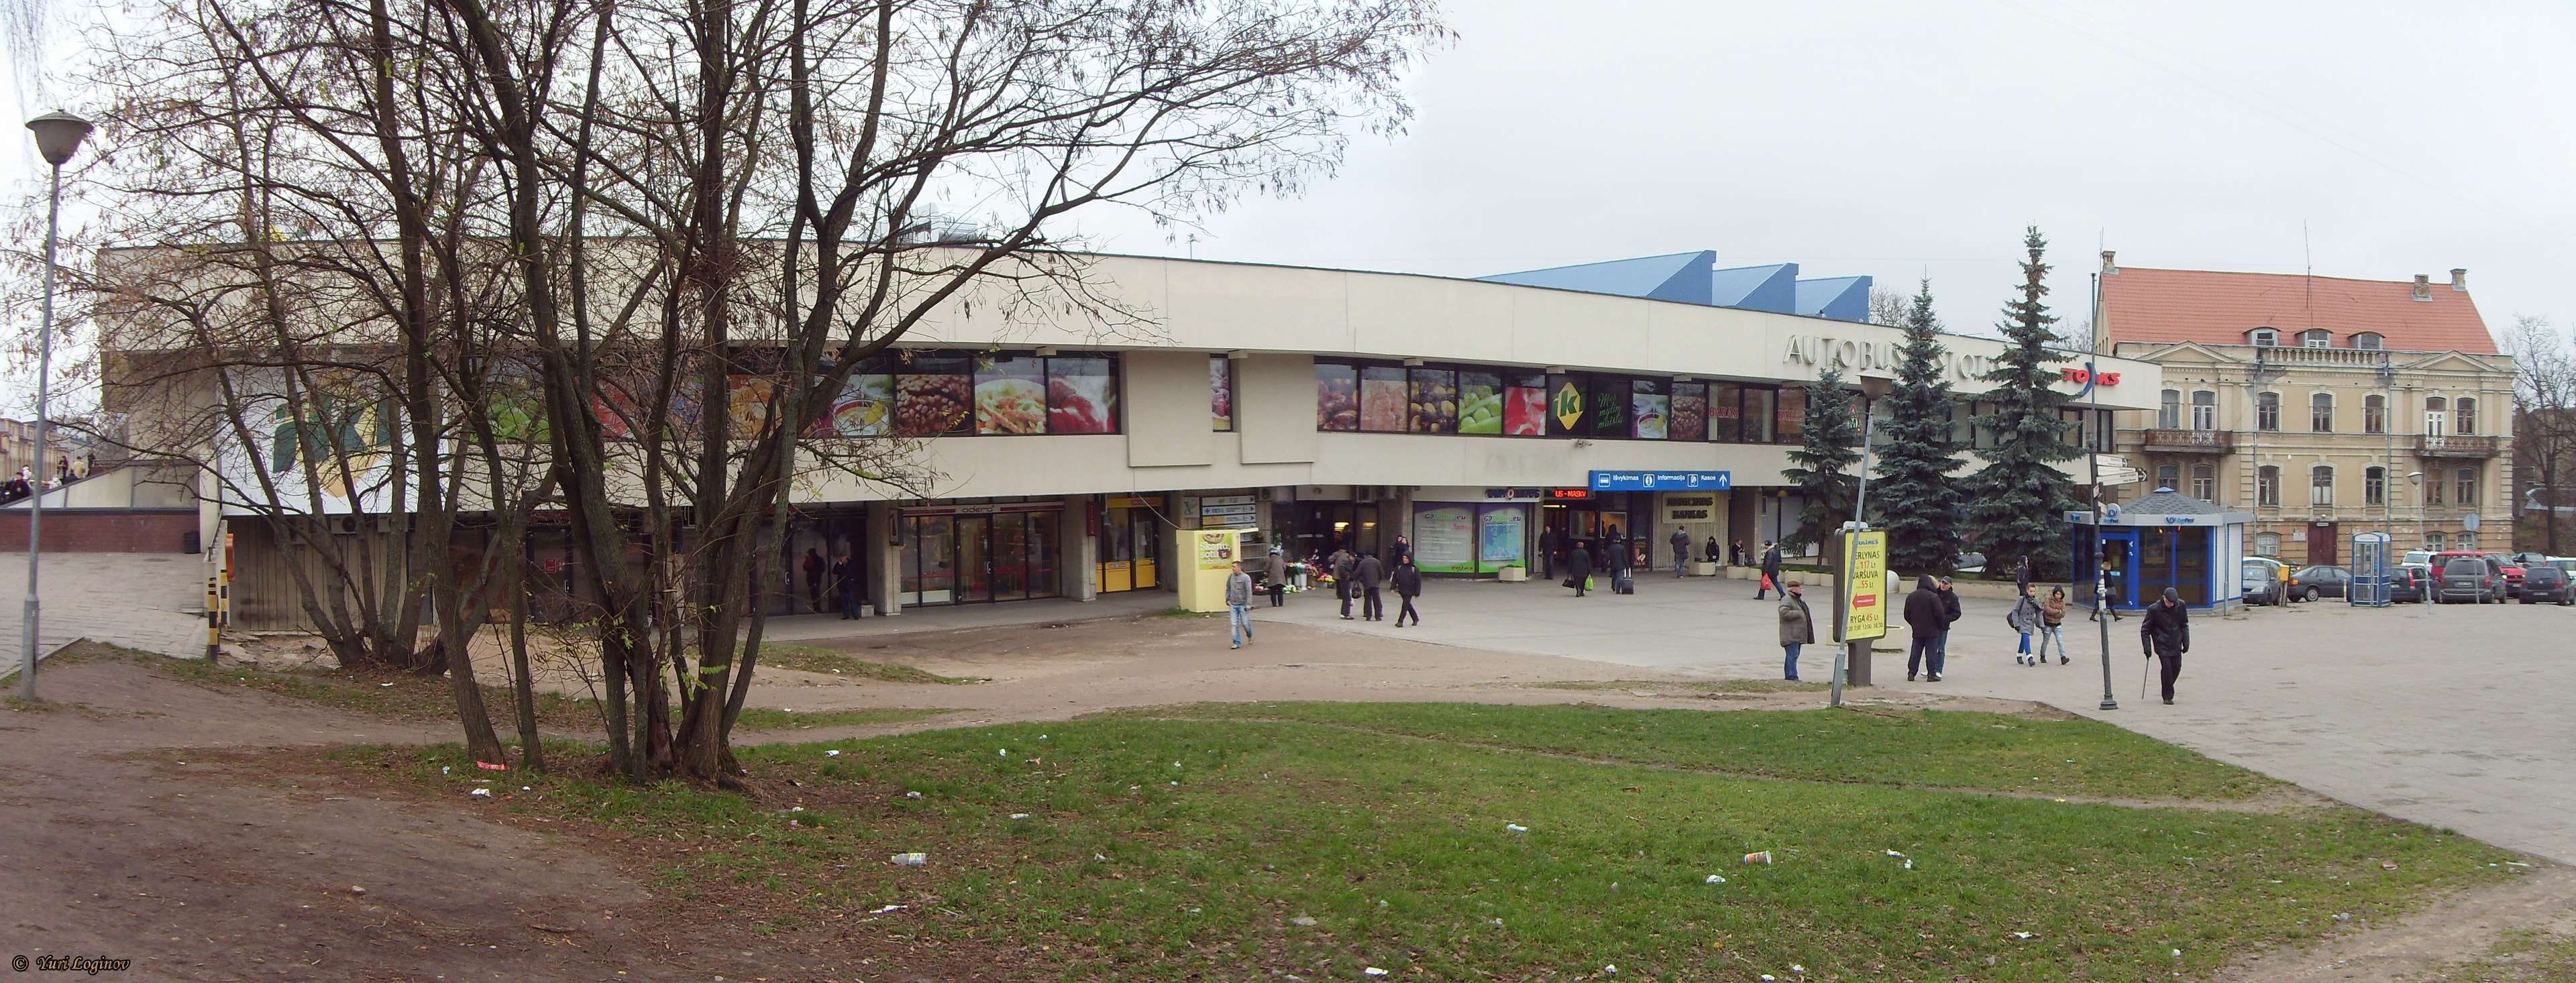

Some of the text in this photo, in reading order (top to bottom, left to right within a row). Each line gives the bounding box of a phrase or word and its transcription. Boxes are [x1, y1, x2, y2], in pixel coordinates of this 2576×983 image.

[1856, 551, 1879, 560] ERLYNAS
[1850, 614, 1865, 624] RYGA
[1866, 613, 1873, 622] 45
